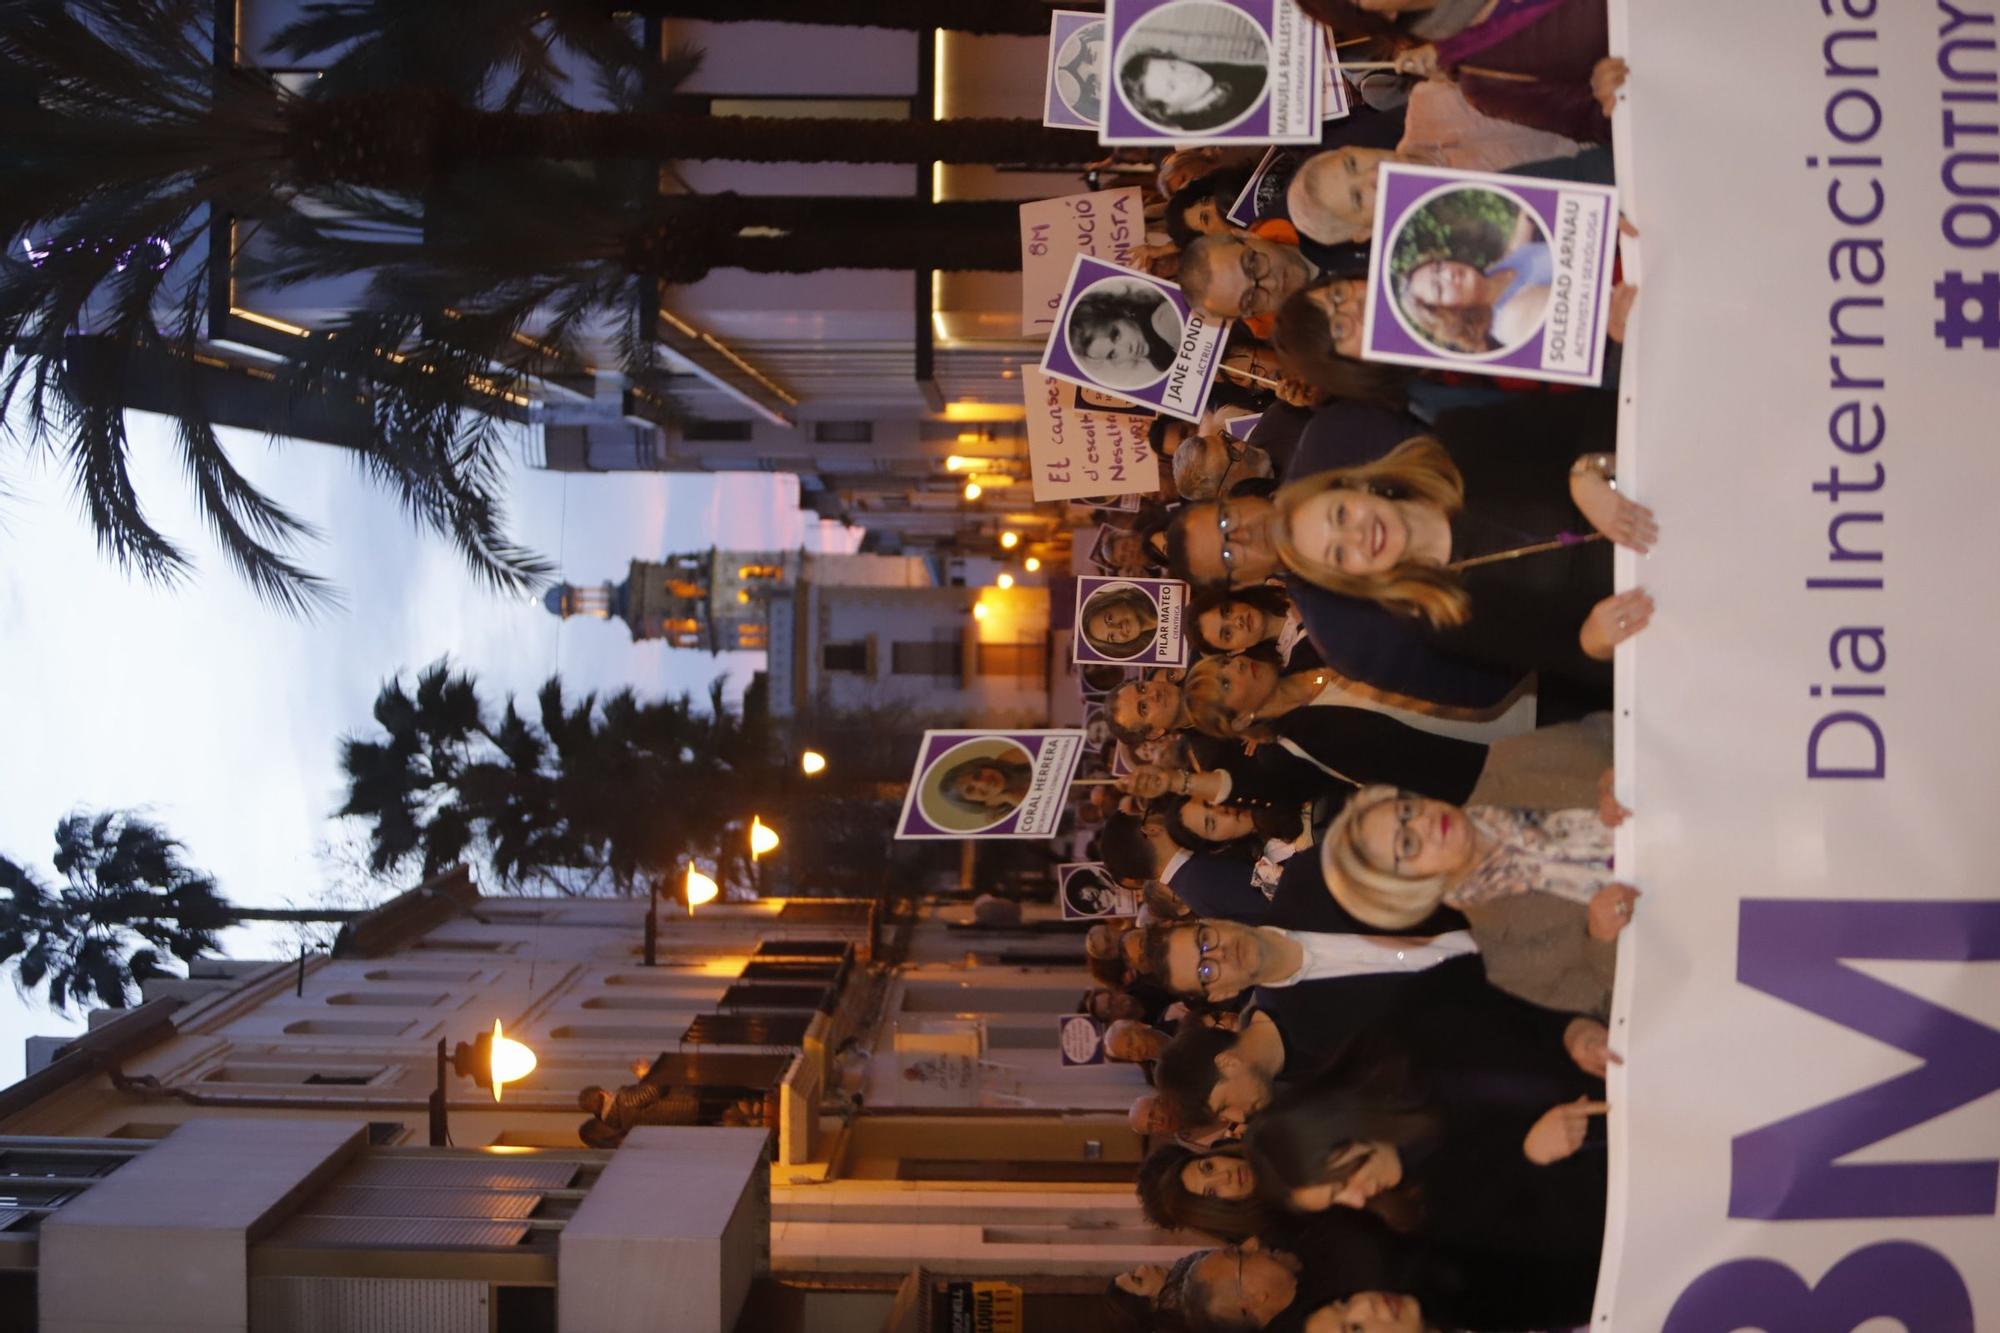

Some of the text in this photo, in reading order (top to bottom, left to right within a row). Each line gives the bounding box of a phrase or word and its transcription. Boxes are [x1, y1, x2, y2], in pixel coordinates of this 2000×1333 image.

[1276, 71, 1290, 134] MANUELA
[1027, 223, 1051, 257] 8M
[1548, 200, 1581, 362] SOLEDAD ARNAU
[1195, 341, 1214, 376] ACTRIU
[1574, 292, 1591, 358] ACTIVISTA
[1166, 363, 1190, 403] JANE
[1079, 413, 1100, 482] d'escolt
[1158, 586, 1171, 656] PILAR MATEO
[1806, 625, 1887, 781] Dia
[1020, 738, 1059, 832] CORAL HERRERA
